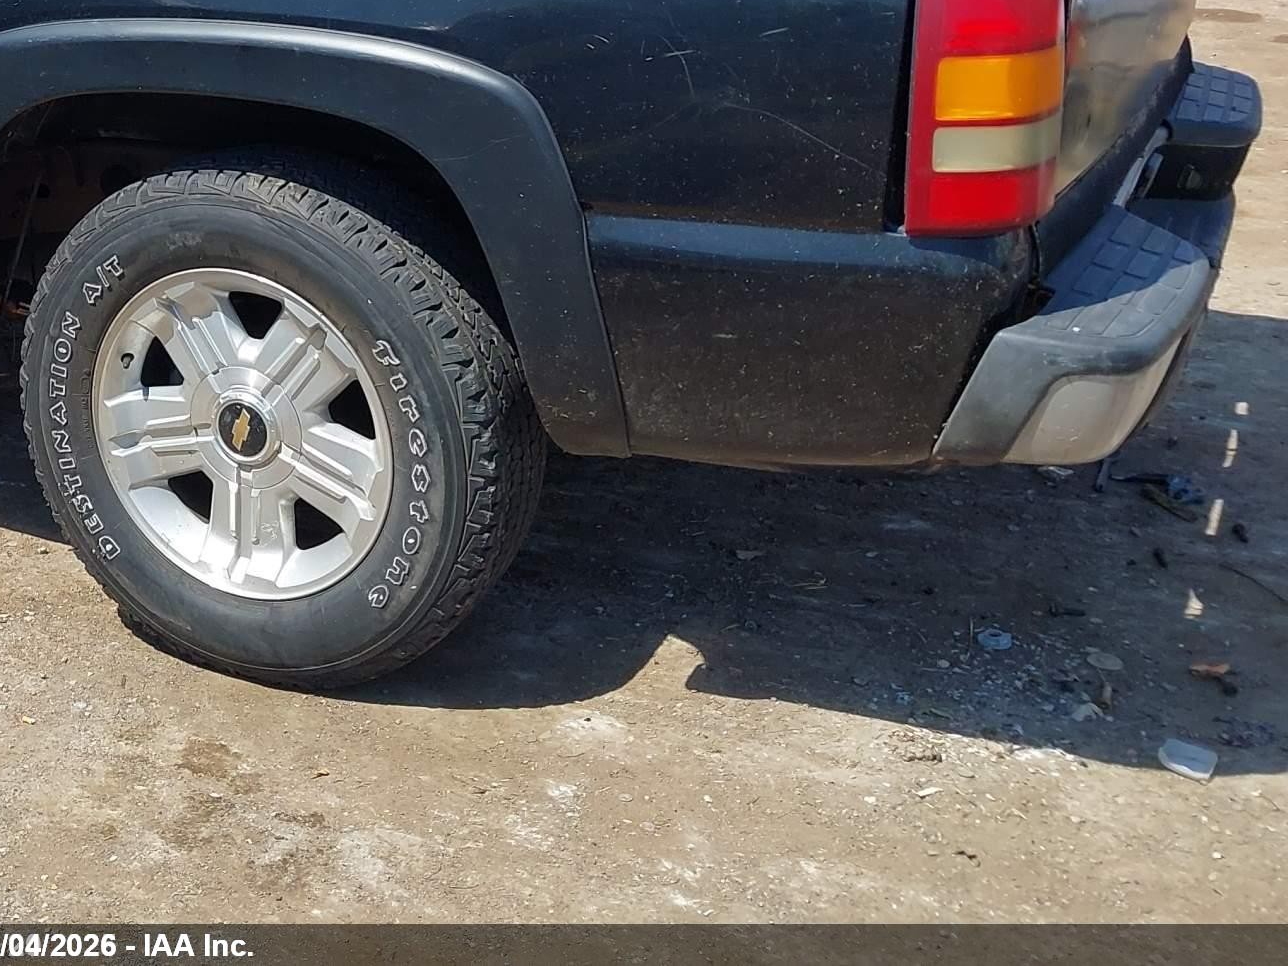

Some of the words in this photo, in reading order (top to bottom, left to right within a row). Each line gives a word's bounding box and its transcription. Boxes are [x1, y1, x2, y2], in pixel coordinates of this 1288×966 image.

[82, 254, 125, 306] A/T
[47, 311, 121, 561] DESTINATION
[367, 340, 431, 609] Firestone
